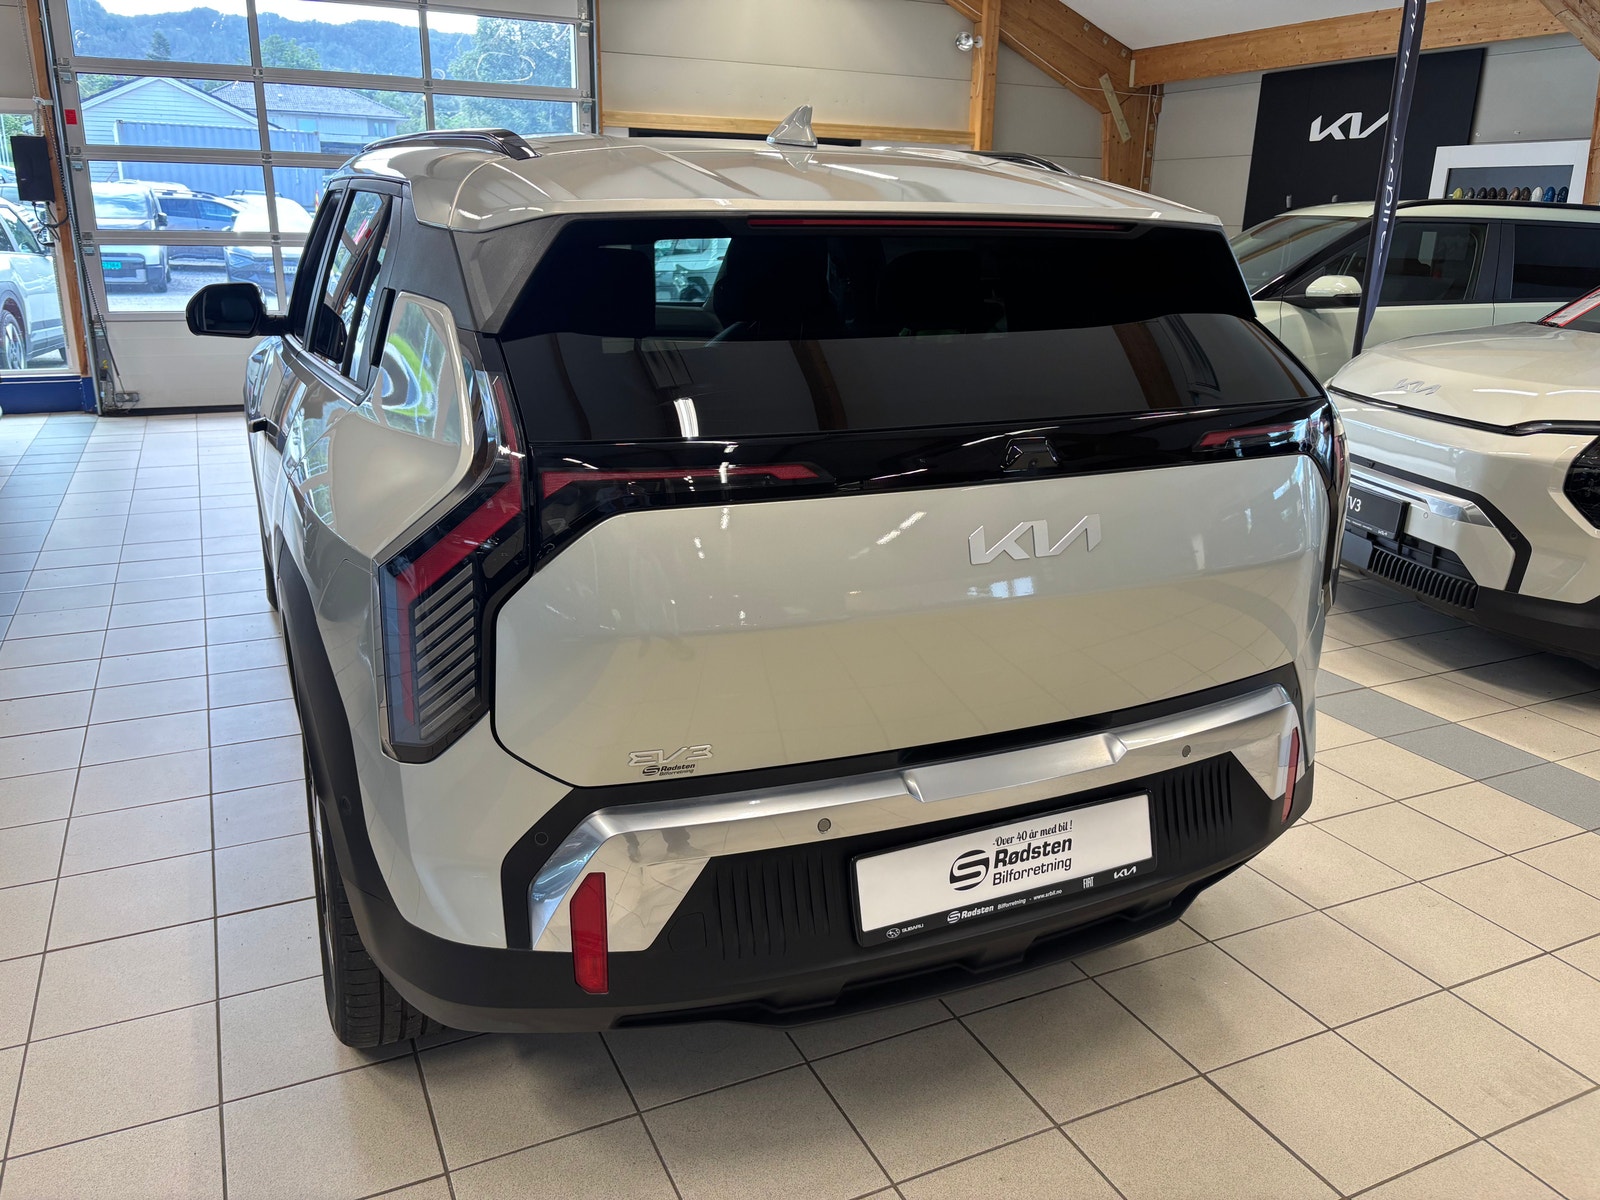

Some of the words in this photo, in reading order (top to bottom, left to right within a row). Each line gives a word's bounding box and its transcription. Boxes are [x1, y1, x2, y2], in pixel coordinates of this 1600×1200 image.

[1393, 378, 1442, 395] KIA
[1348, 496, 1362, 512] V3
[968, 513, 1102, 565] KIA
[628, 744, 713, 766] EV3
[1016, 830, 1028, 842] 40
[1028, 829, 1039, 839] år
[1040, 824, 1057, 836] med
[993, 837, 1073, 869] Rødsten
[992, 857, 1072, 886] Bilforretning
[1113, 865, 1137, 879] KIA
[1083, 876, 1094, 889] FIAT
[901, 923, 924, 933] SUBARU
